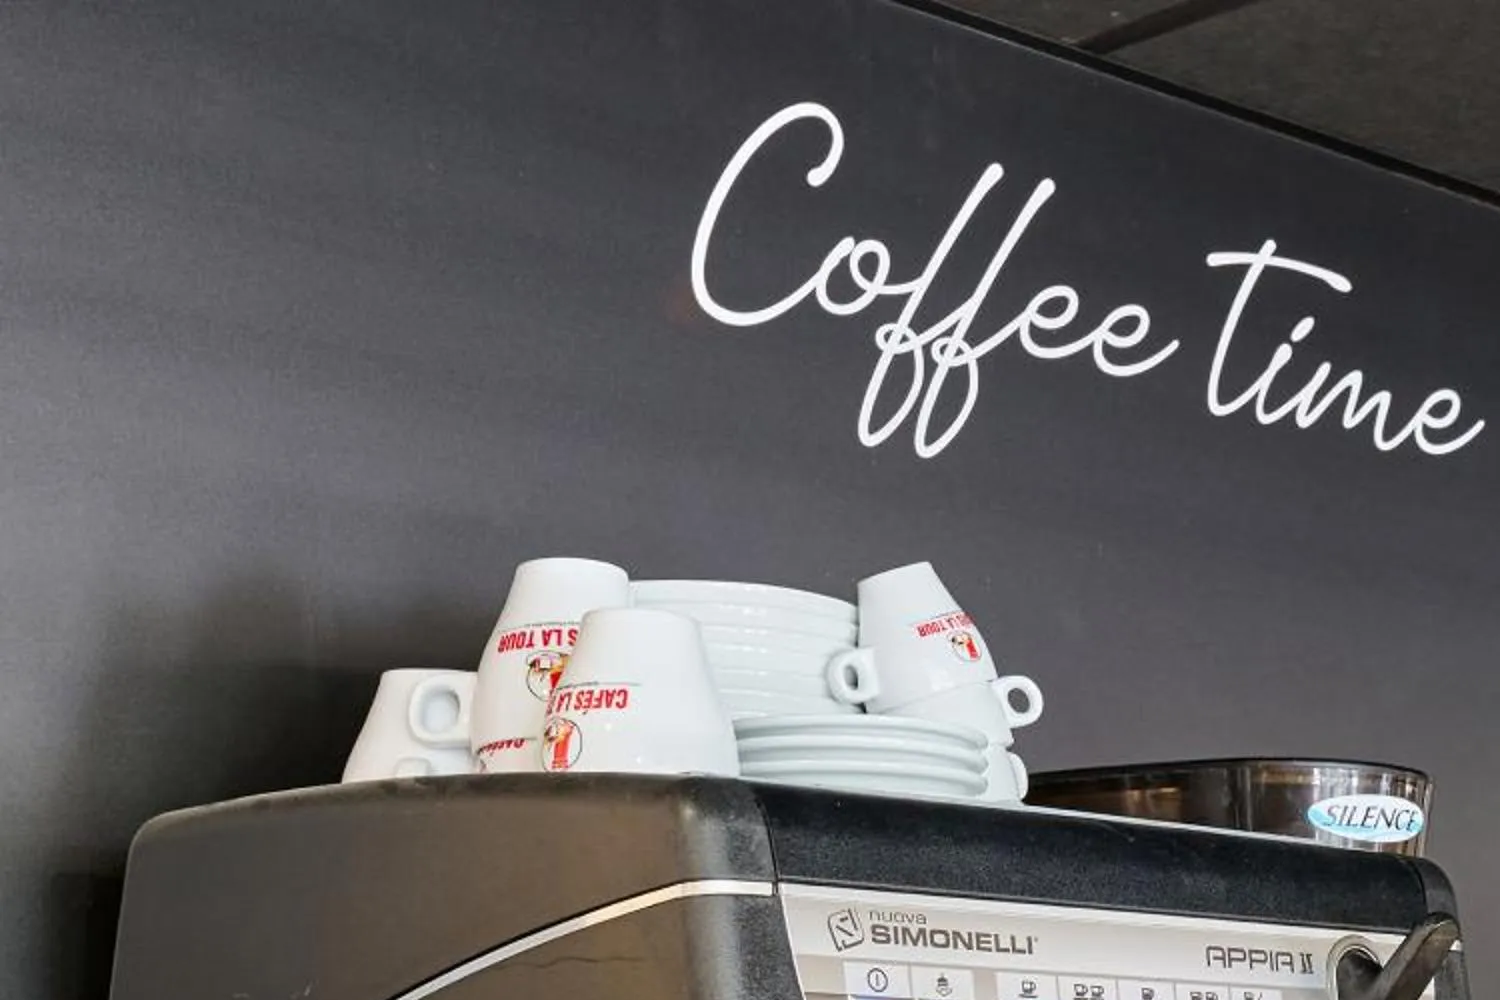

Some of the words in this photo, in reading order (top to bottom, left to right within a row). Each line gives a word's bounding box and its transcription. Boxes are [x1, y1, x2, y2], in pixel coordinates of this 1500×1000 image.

[690, 102, 1179, 458] Coffee
[497, 631, 535, 653] TOUR
[541, 628, 565, 647] LA
[573, 688, 629, 716] CAFÉS
[1323, 804, 1420, 832] SILENCE
[868, 910, 928, 925] nuova
[870, 924, 1037, 955] SIMONELLI
[1205, 945, 1295, 974] APPIA
